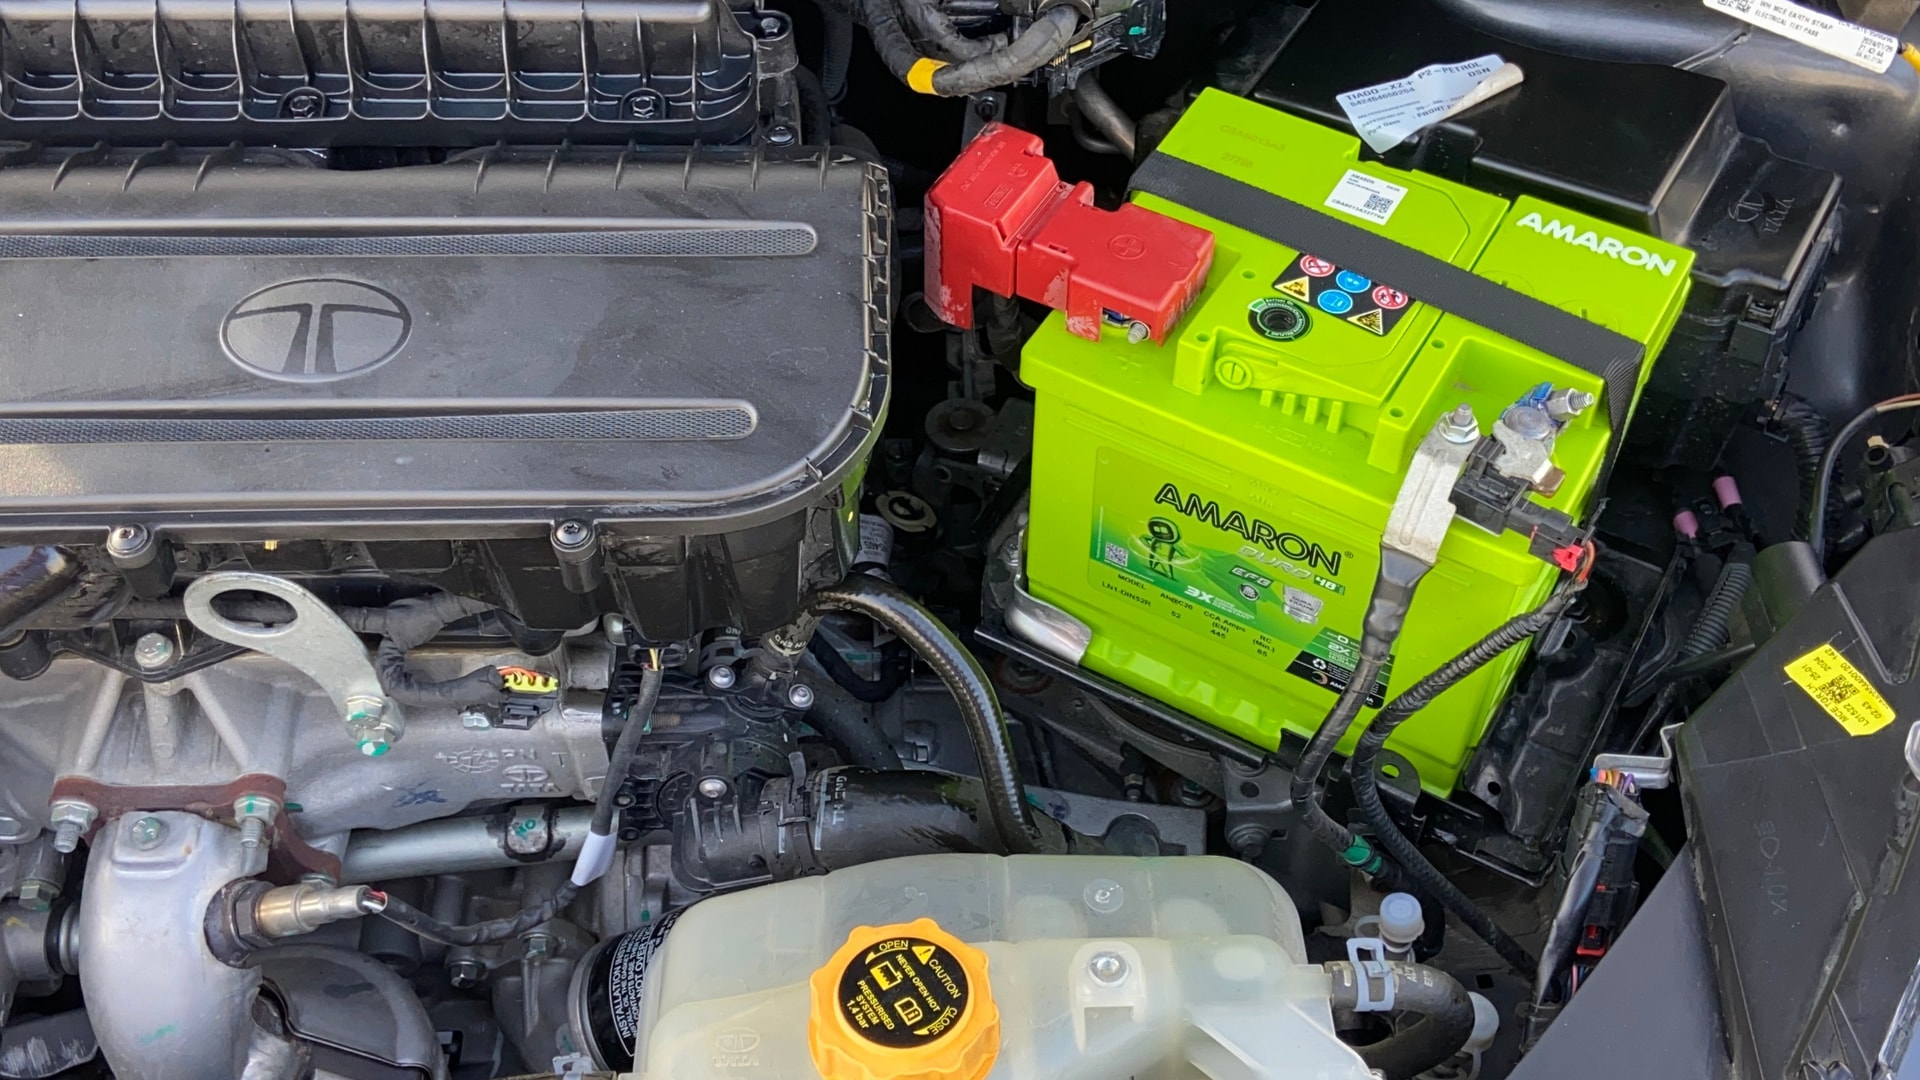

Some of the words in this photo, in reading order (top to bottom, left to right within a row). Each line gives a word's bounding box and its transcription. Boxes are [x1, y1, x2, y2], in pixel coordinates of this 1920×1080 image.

[1467, 67, 1492, 78] DSN
[1516, 212, 1677, 276] AMARON
[1154, 482, 1342, 577] AMARON
[1239, 544, 1312, 579] DURO
[1117, 573, 1146, 591] MODEL
[1184, 585, 1214, 605] 3X
[1170, 610, 1182, 619] 52
[1202, 610, 1221, 622] CCA
[1222, 619, 1246, 633] Amps
[1209, 628, 1227, 640] 445
[1259, 634, 1272, 644] RC
[1813, 656, 1832, 672] 2024
[1806, 682, 1818, 694] LH
[1815, 692, 1832, 708] TGR
[1829, 706, 1849, 723] MCE
[635, 942, 647, 971] OVER
[879, 940, 909, 951] OPEN
[895, 953, 915, 979] NEVER
[912, 975, 929, 998] OPEN
[925, 994, 941, 1013] HOT
[928, 958, 961, 999] CAUTION
[612, 963, 632, 1039] INSTALLATION
[855, 994, 880, 1026] SYSTEM
[856, 979, 895, 1031] PRESSURISED
[846, 999, 857, 1015] 1.4
[855, 1010, 870, 1030] bar
[929, 1007, 958, 1036] CLOSE
